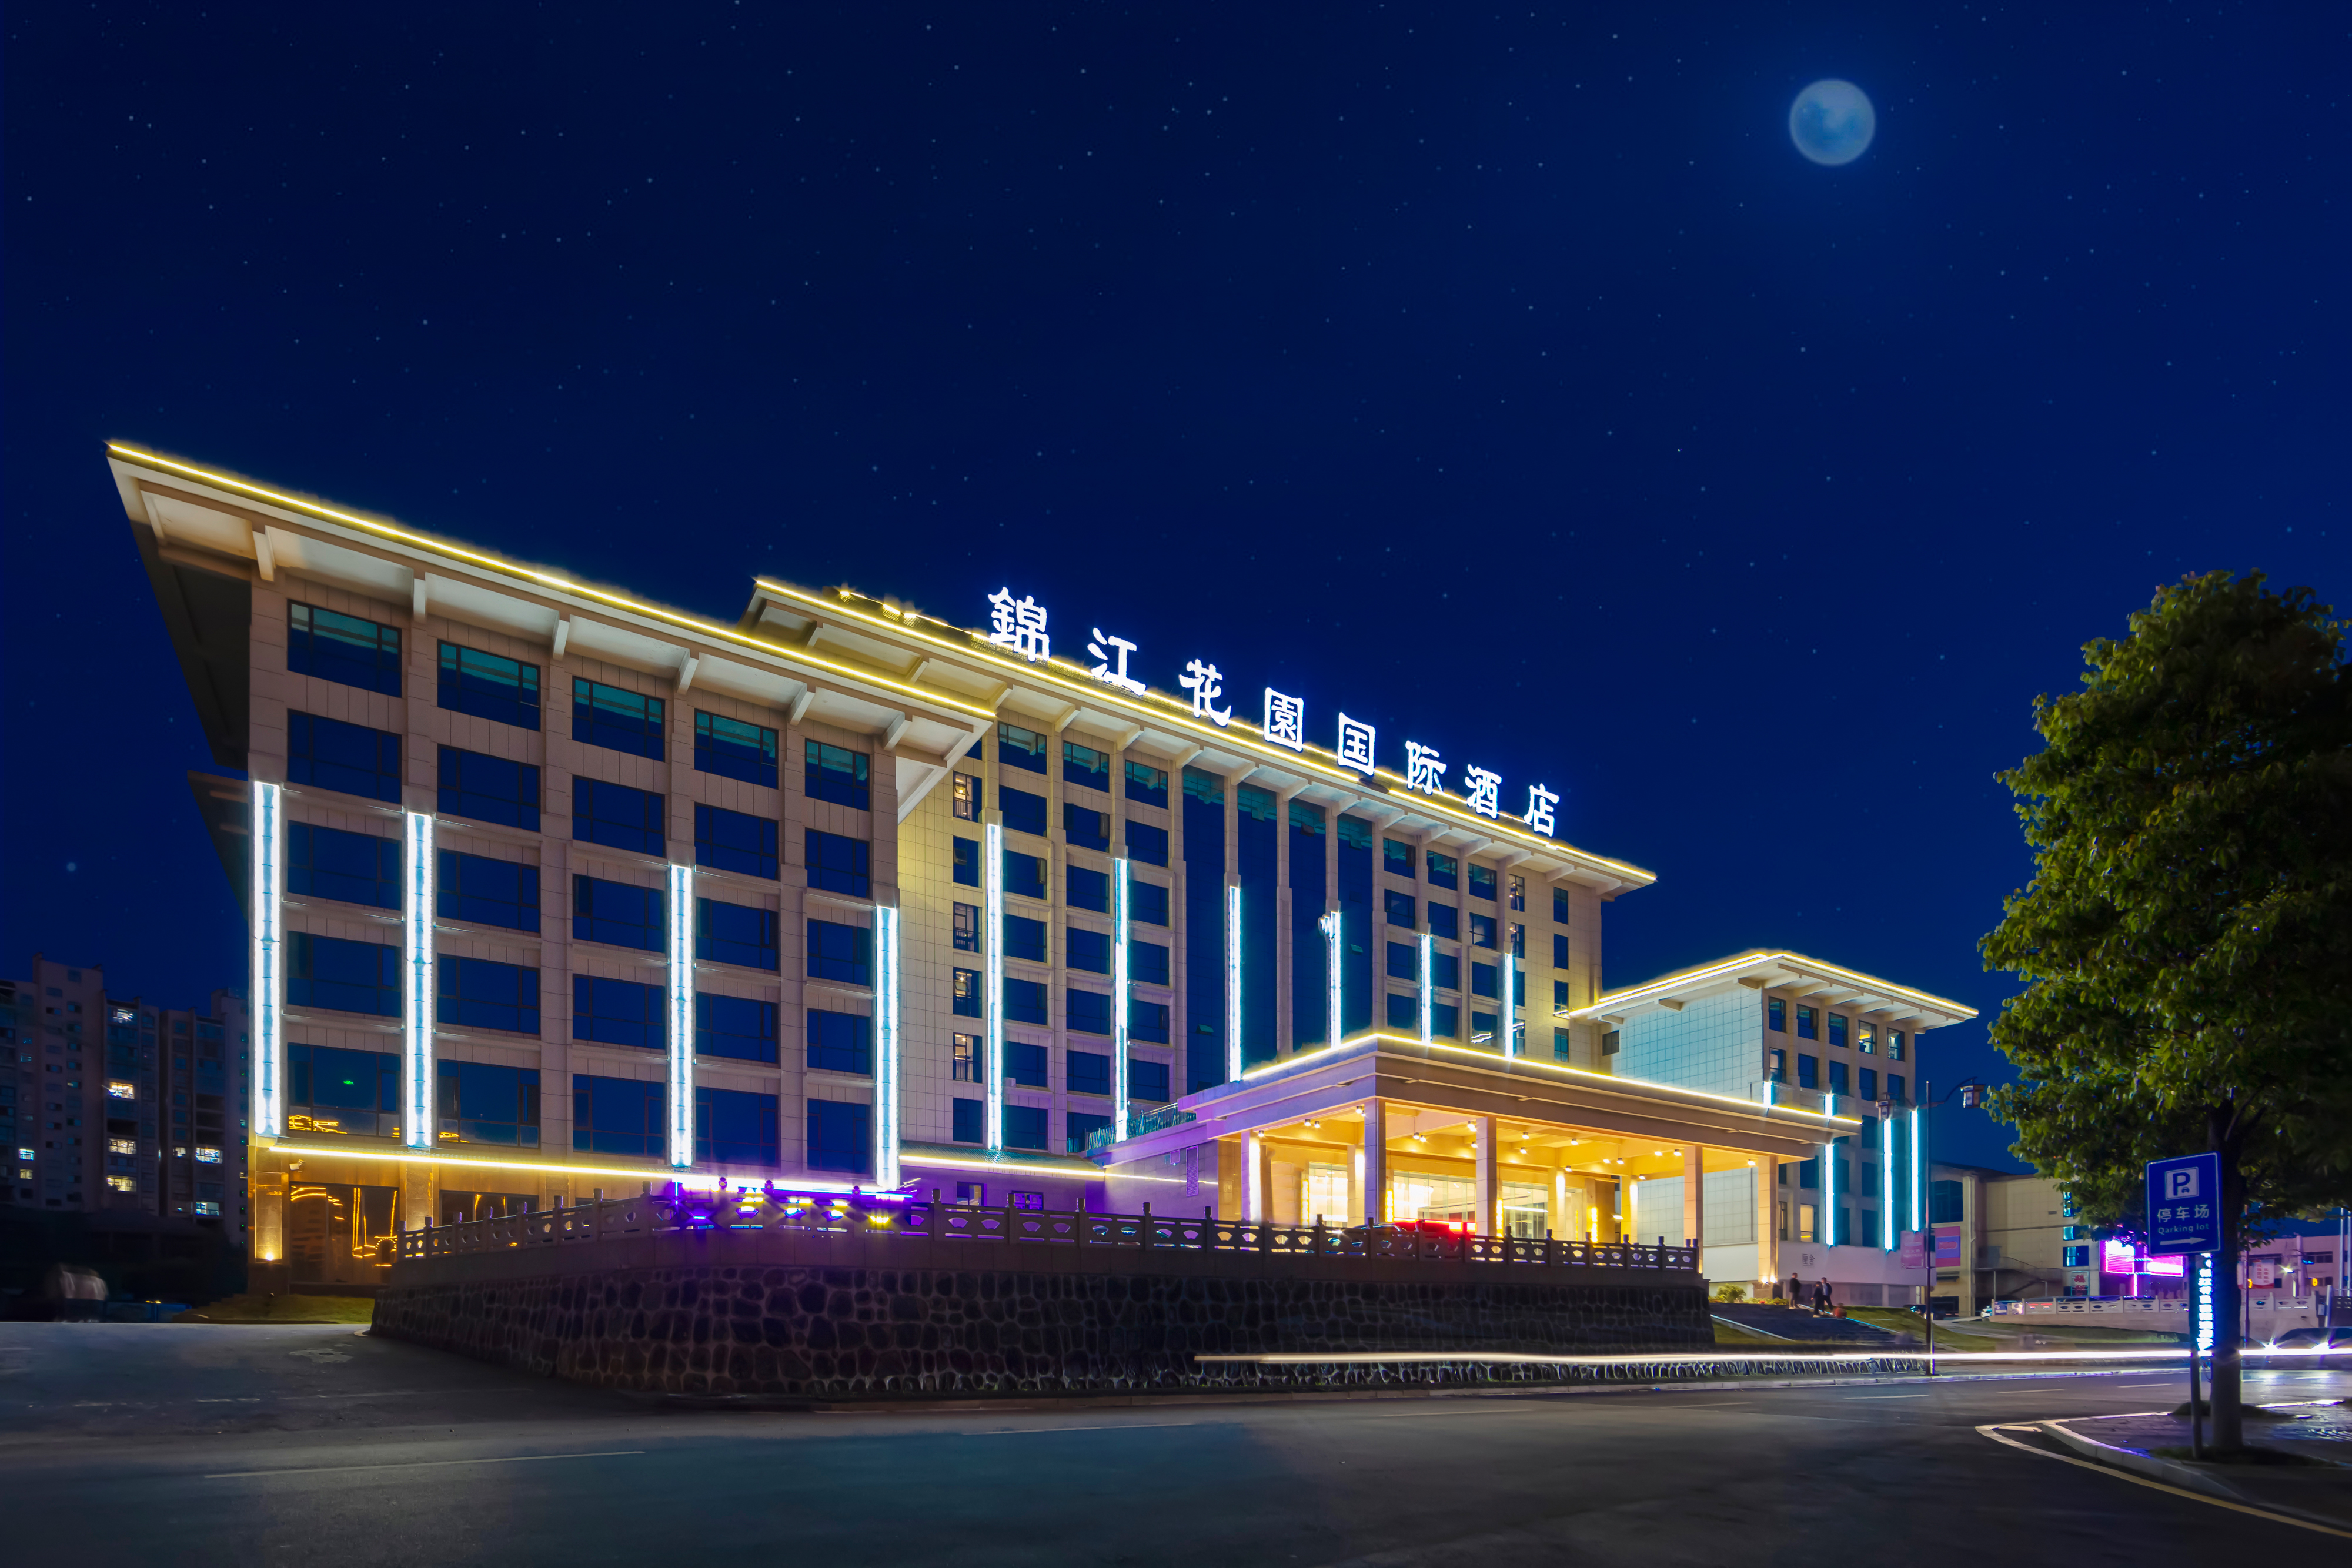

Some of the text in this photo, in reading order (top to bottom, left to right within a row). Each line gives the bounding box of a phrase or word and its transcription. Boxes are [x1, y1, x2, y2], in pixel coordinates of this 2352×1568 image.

[988, 586, 1560, 837] 錦江花園国际酒店
[2173, 1172, 2191, 1196] P
[2157, 1204, 2209, 1223] 停车场
